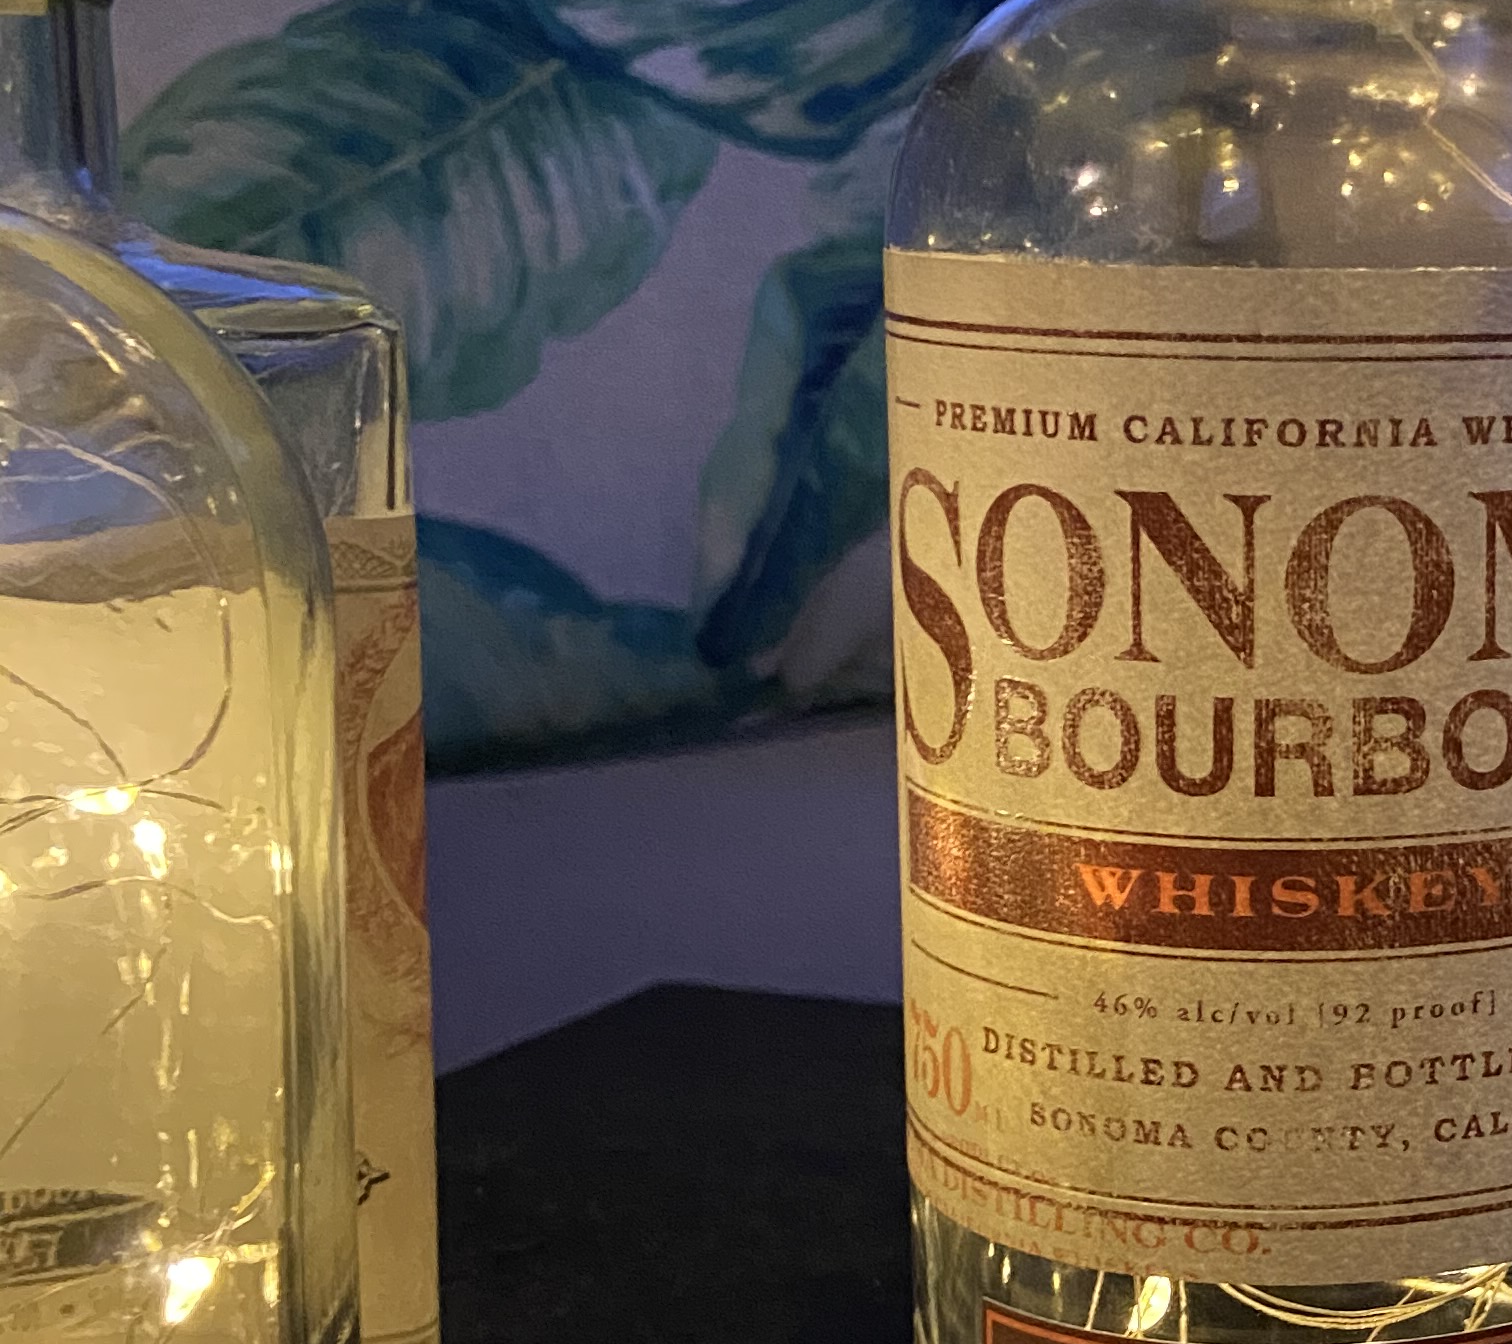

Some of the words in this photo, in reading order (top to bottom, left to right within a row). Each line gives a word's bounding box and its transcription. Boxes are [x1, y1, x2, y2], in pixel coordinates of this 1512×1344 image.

[934, 399, 1099, 442] PREMIUM
[1122, 415, 1438, 449] CALIFORNIA
[1073, 863, 1502, 918] WHISKEY
[1092, 991, 1158, 1020] 46%
[982, 1025, 1200, 1088] DISTILLED
[1224, 1063, 1324, 1093] AND
[1029, 1101, 1194, 1150] SONOMA
